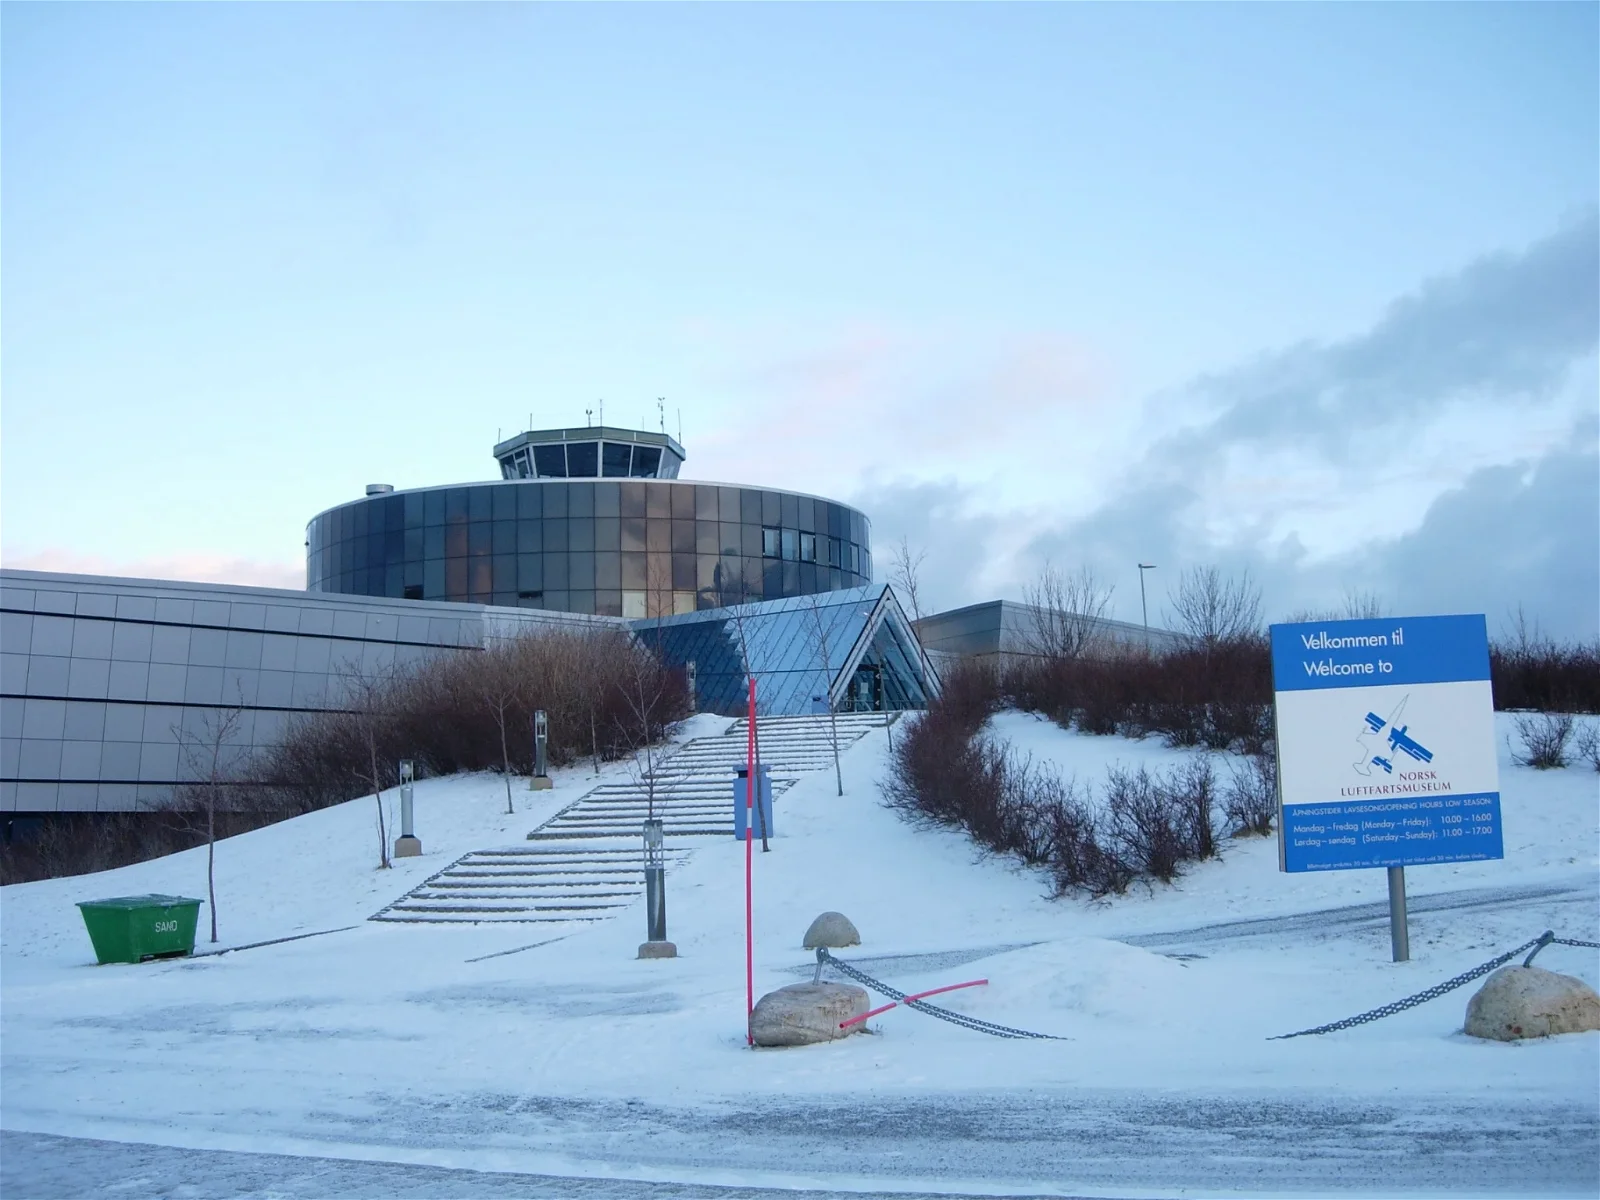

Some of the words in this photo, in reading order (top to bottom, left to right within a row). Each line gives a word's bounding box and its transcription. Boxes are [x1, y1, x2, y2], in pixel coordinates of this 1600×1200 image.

[1301, 631, 1387, 650] Velkommen
[1391, 628, 1404, 645] til
[1303, 658, 1374, 677] Welcome
[1378, 659, 1393, 673] to
[1399, 771, 1437, 781] NORSK
[1341, 781, 1451, 797] LUFTFARTSMUSEUM
[1292, 807, 1341, 817] ÅPNINGSTIDER
[1419, 801, 1443, 809] HOURS
[1445, 799, 1461, 808] LOW
[155, 920, 178, 933] SAND
